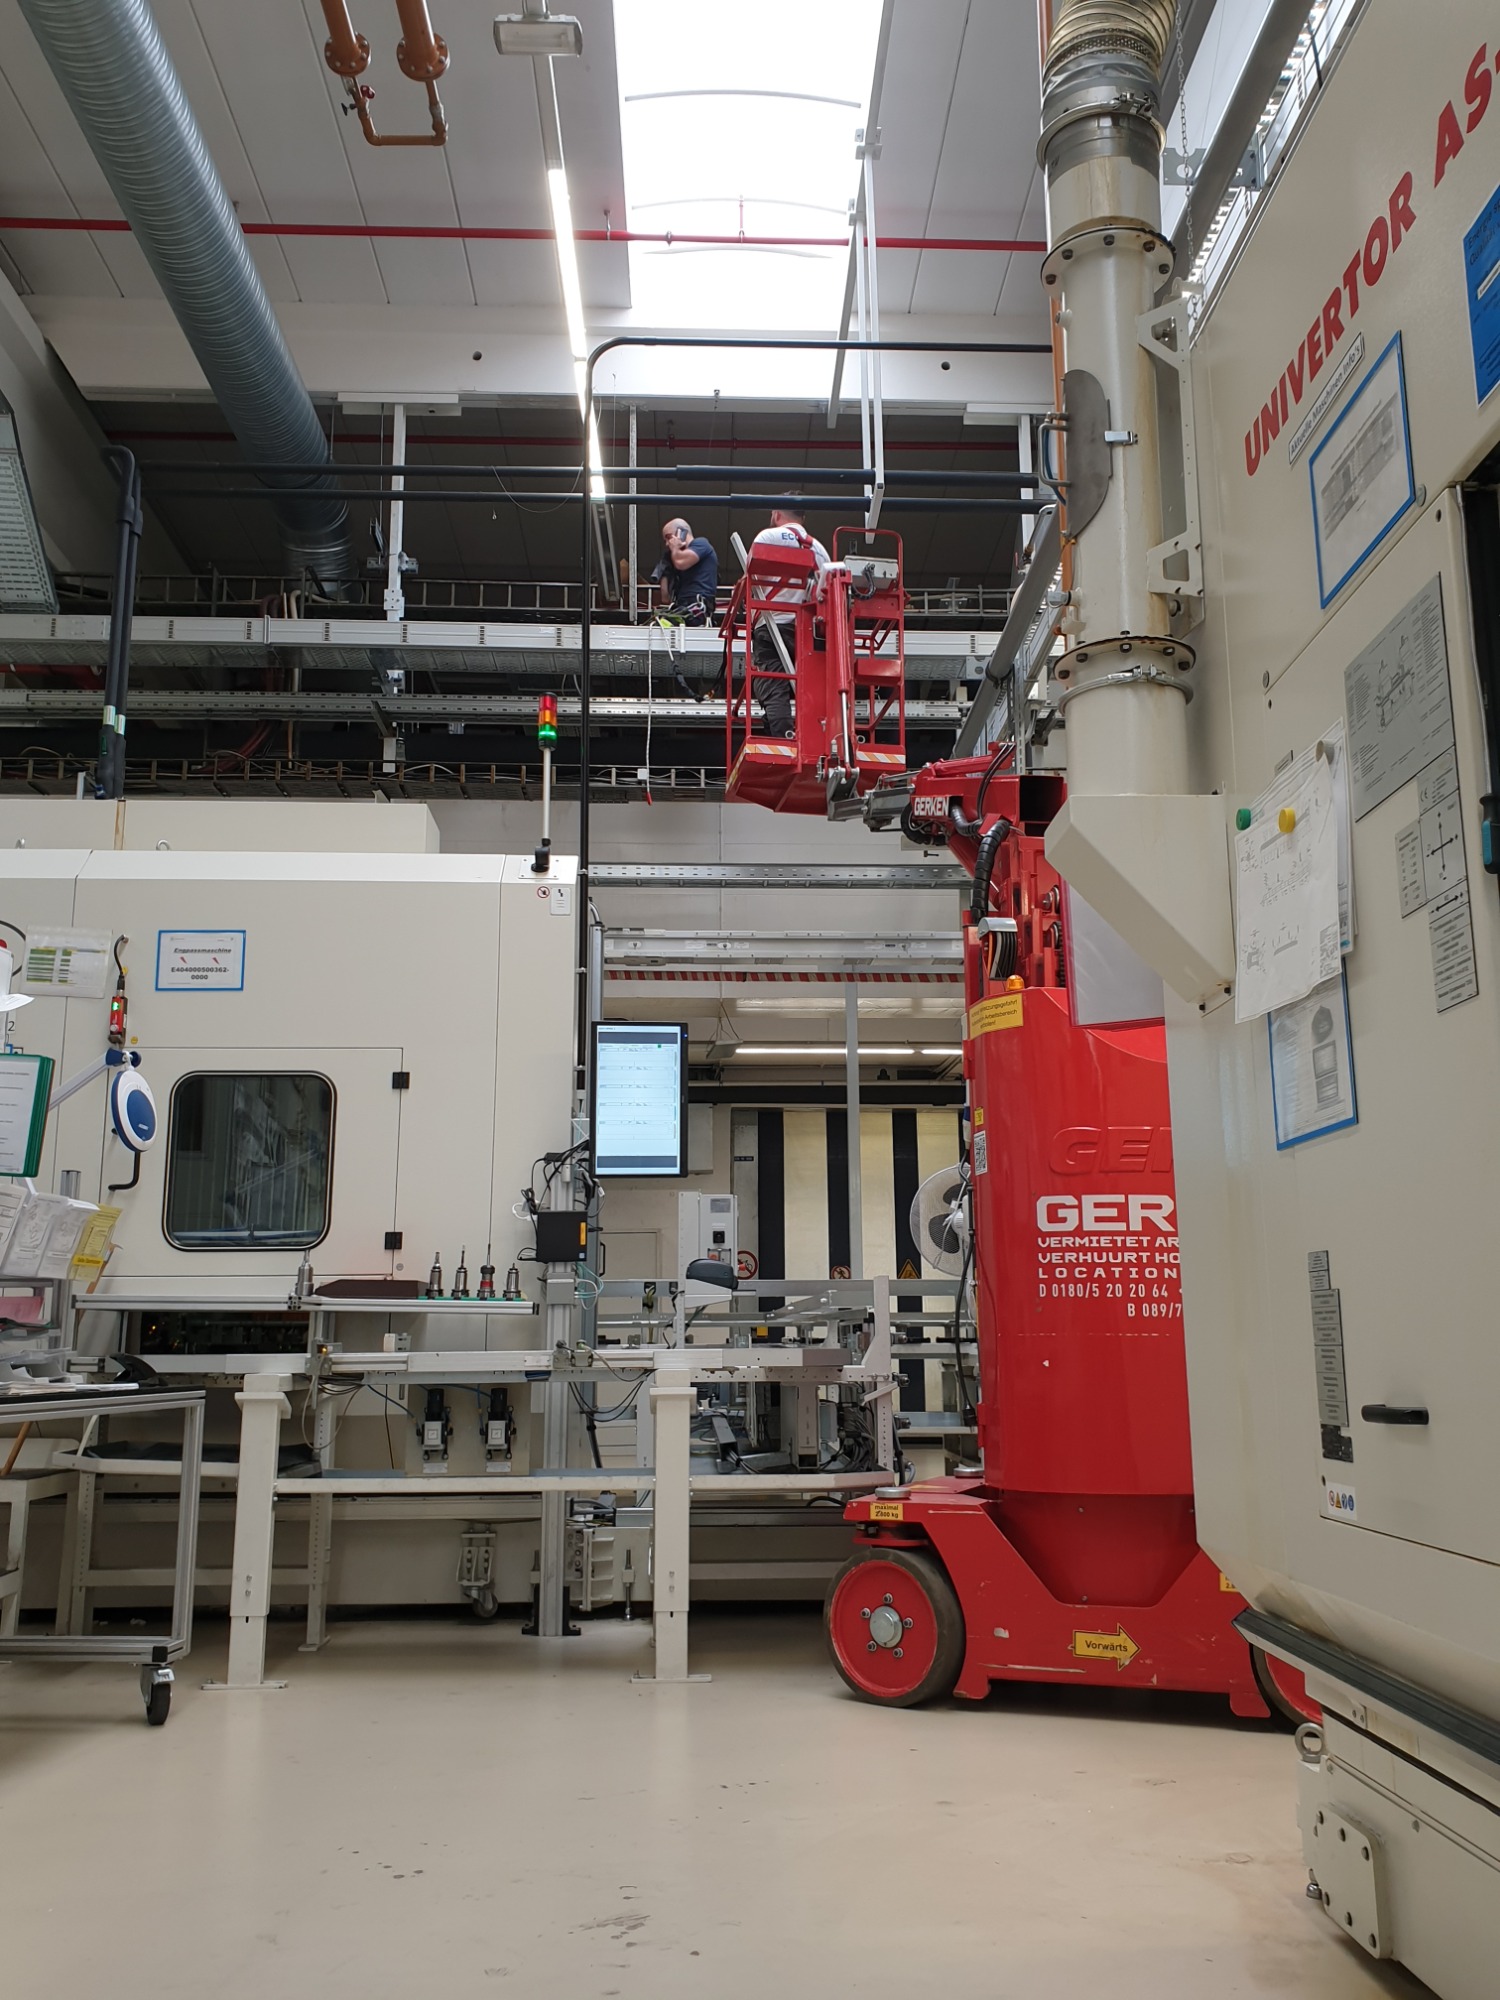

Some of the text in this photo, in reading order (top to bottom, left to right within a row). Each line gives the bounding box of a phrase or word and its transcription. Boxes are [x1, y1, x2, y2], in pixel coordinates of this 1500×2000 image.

[1244, 171, 1417, 477] UNIVERTOR
[1434, 42, 1500, 189] AS
[1291, 419, 1312, 455] Aktuelle
[1312, 372, 1343, 422] Maschinen
[914, 797, 950, 817] GERKEN
[1036, 1194, 1177, 1232] GER
[1037, 1236, 1151, 1248] VERMIETET
[1038, 1252, 1151, 1264] VERHUURT
[1038, 1267, 1178, 1279] LOCATION
[1039, 1282, 1168, 1299] D 0180/5 20 20 64
[1127, 1302, 1182, 1319] B 089/7
[1085, 1639, 1129, 1652] Vorwärts
